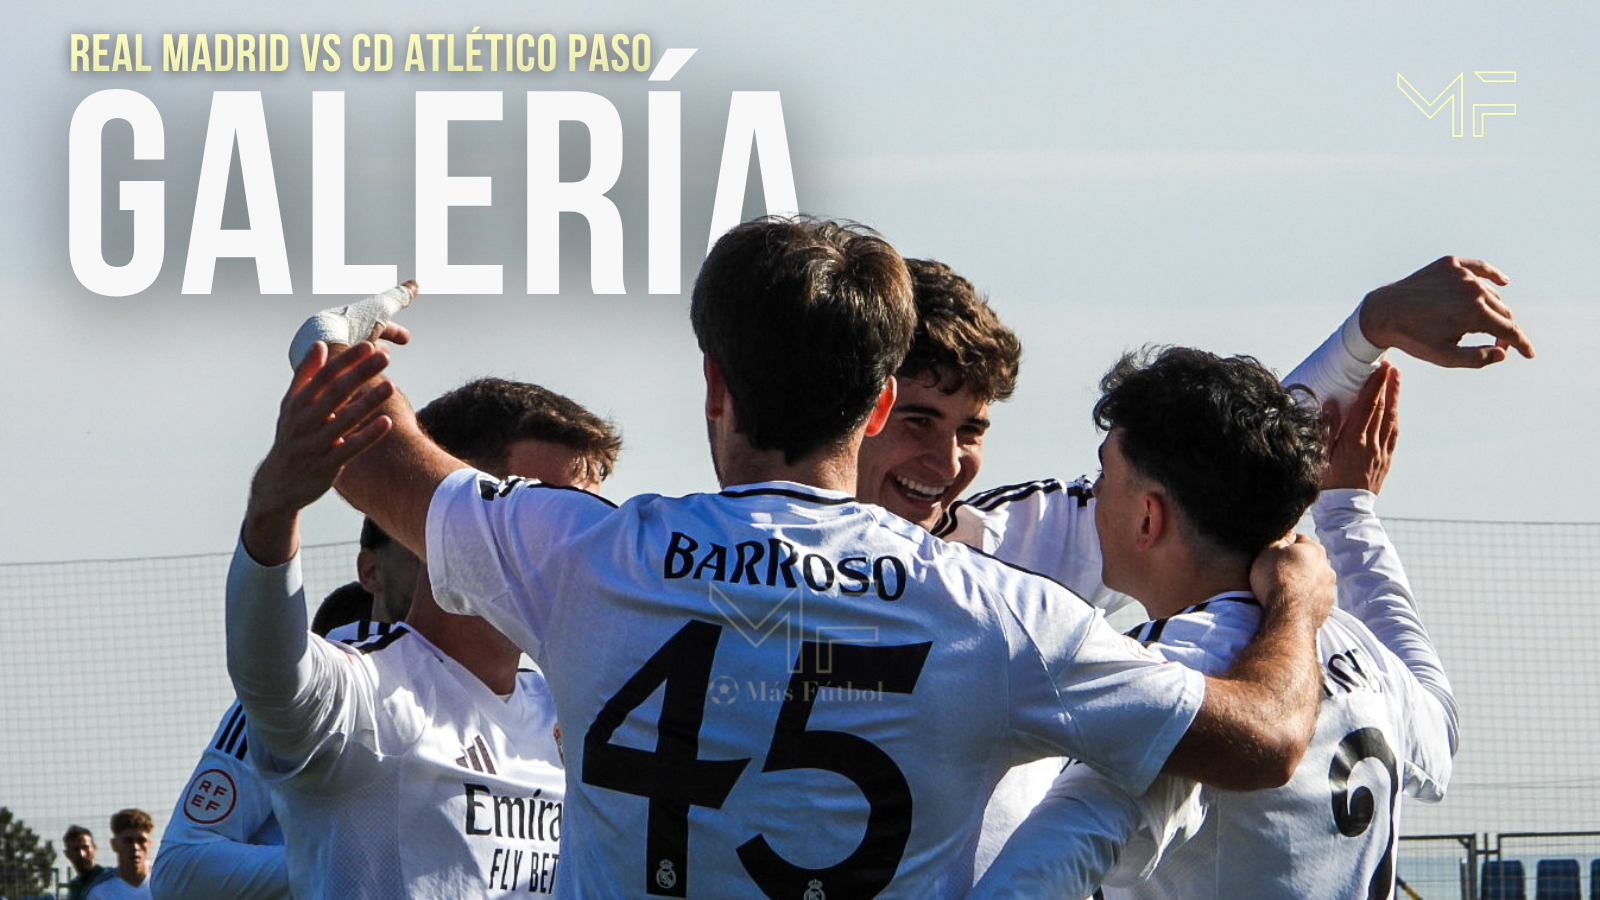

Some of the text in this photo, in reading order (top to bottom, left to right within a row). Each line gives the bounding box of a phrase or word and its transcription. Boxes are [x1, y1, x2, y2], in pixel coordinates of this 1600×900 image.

[664, 531, 907, 602] BARROSO
[582, 619, 933, 900] 45
[489, 848, 523, 891] FLY
